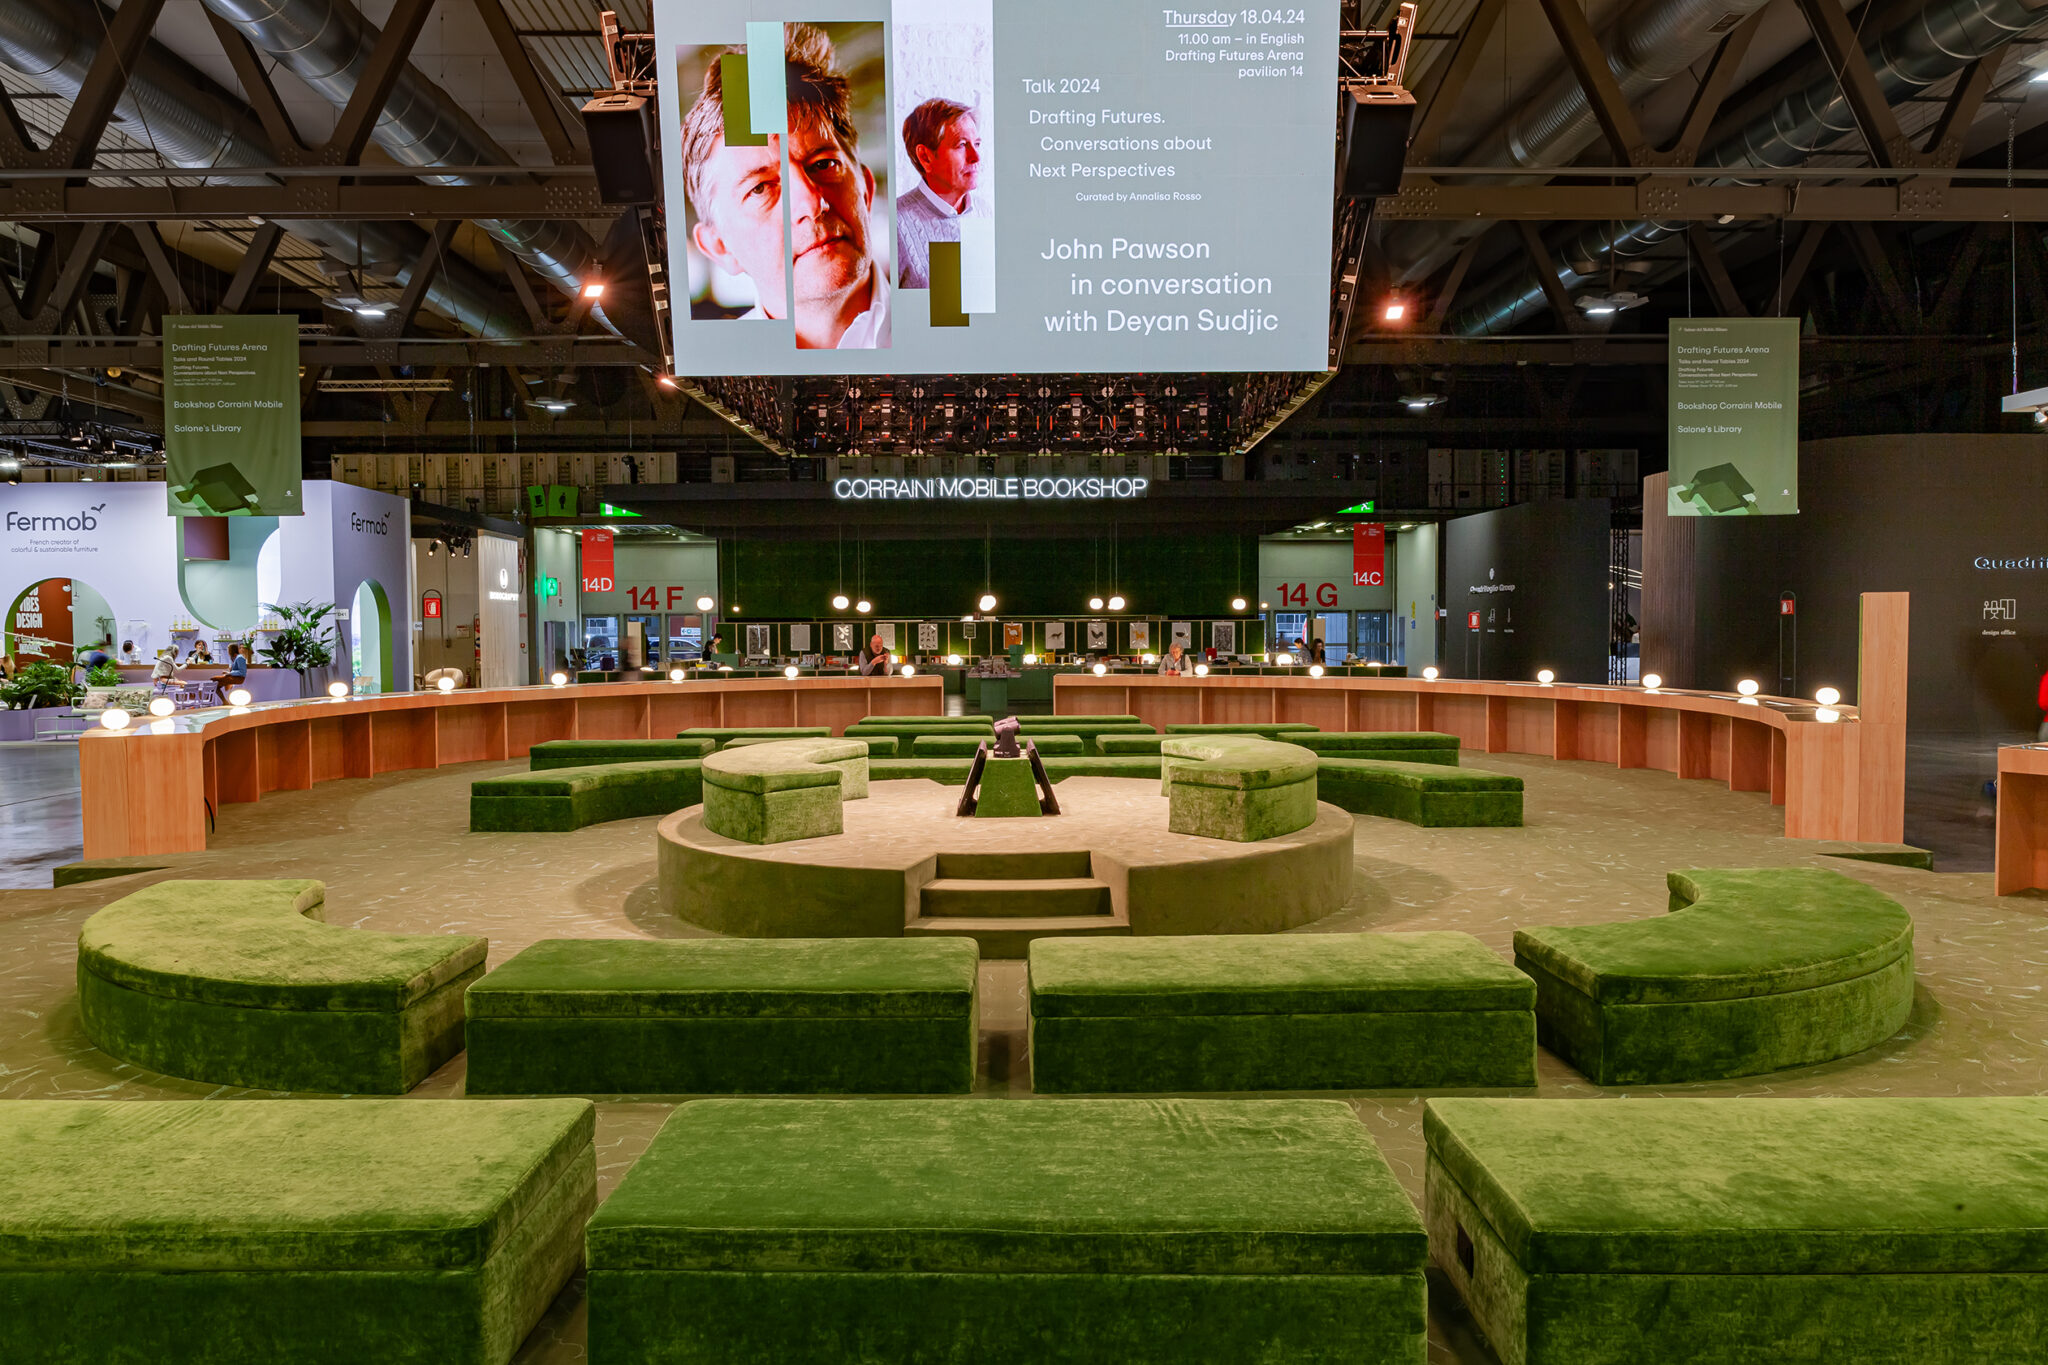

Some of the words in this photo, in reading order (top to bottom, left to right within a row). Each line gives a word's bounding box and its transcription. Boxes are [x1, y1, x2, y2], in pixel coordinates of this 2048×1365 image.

[1162, 10, 1237, 28] Thursday
[1240, 9, 1305, 25] 18.04.24
[1177, 33, 1209, 45] 11.00
[1211, 35, 1231, 45] am
[1246, 33, 1257, 45] in
[1260, 33, 1305, 47] English
[1165, 50, 1216, 64] Drafting
[1219, 50, 1265, 61] Futures
[1266, 50, 1304, 61] Arena
[1238, 66, 1287, 80] pavilion
[1289, 66, 1304, 77] 14
[1021, 79, 1056, 94] Talk
[1059, 79, 1101, 94] 2024
[1029, 110, 1096, 128] Drafting
[1101, 110, 1166, 124] Futures.
[1040, 137, 1160, 152] Conversations
[1163, 136, 1212, 151] about
[1029, 164, 1067, 178] Next
[1071, 163, 1176, 180] Perspectives
[1075, 192, 1114, 202] Curated
[1116, 192, 1128, 203] by
[1128, 191, 1171, 201] Annalisa
[1172, 191, 1202, 201] Rosso
[1040, 238, 1103, 260] John
[1112, 238, 1210, 260] Pawson
[1071, 273, 1093, 296] in
[1100, 272, 1272, 296] conversation
[1044, 310, 1098, 332] with
[1107, 310, 1189, 336] Deyan
[1197, 309, 1279, 335] Sudjic
[172, 343, 206, 353] Drafting
[209, 343, 240, 352] Futures
[242, 343, 267, 352] Arena
[1678, 345, 1711, 356] Drafting
[1713, 345, 1743, 354] Futures
[1745, 345, 1769, 354] Arena
[174, 400, 215, 409] Bookshop
[218, 400, 251, 409] Corraini
[254, 400, 283, 409] Mobile
[1678, 401, 1717, 411] Bookshop
[1720, 401, 1752, 410] Corraini
[1755, 401, 1782, 410] Mobile
[175, 424, 209, 433] Salone's
[212, 424, 241, 434] Library
[1678, 424, 1712, 434] Salone's
[1714, 425, 1742, 435] Library
[835, 478, 934, 498] CORRAINI
[938, 478, 1018, 498] MOBILE
[1022, 478, 1148, 498] BOOKSHOP
[6, 511, 97, 531] Fermob
[351, 512, 388, 535] Fermob
[30, 538, 49, 546] French
[73, 538, 79, 546] of
[40, 545, 72, 553] sustainable
[74, 545, 98, 553] furniture
[583, 578, 612, 591] 14D
[1354, 572, 1380, 585] 14C
[626, 586, 659, 610] 14
[667, 587, 684, 610] F
[1277, 583, 1309, 607] 14
[1317, 583, 1337, 607] G
[16, 613, 43, 628] DESIGN
